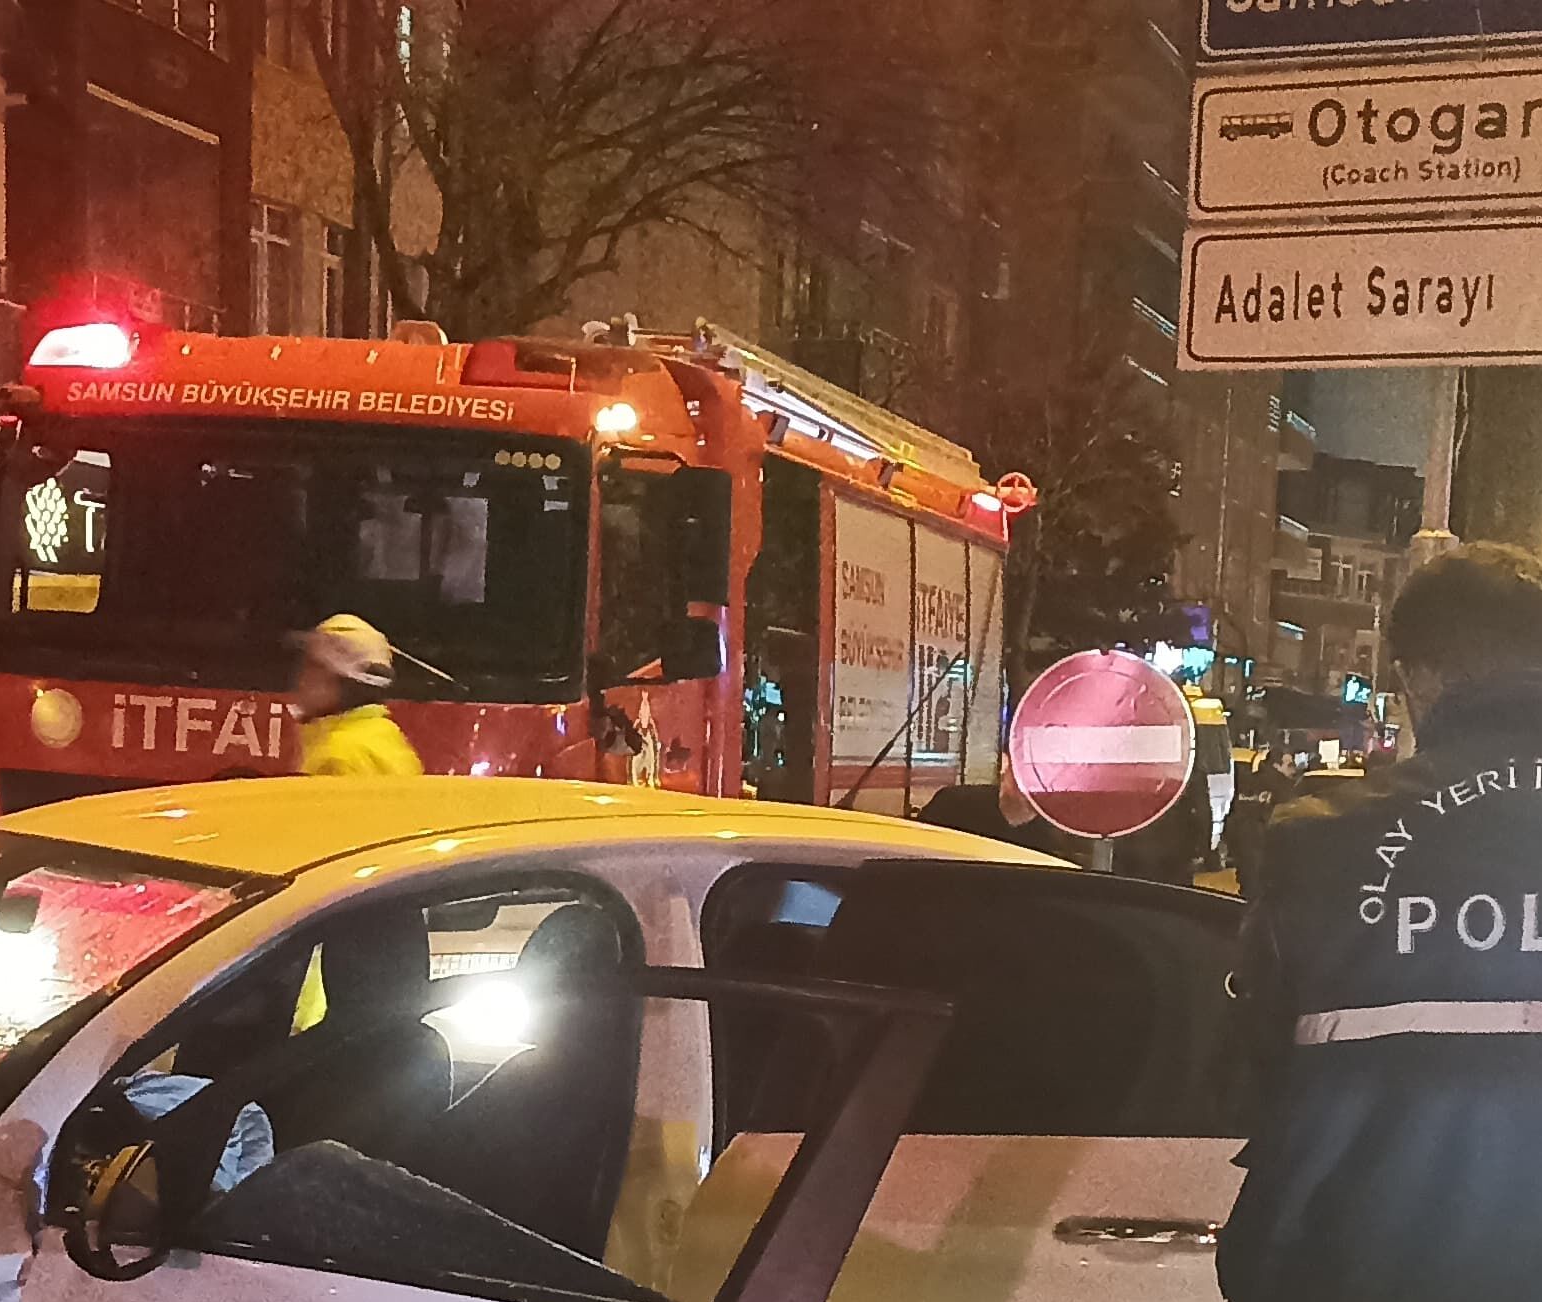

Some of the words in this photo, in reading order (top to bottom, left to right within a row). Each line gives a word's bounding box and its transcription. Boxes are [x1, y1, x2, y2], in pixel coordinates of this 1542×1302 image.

[1322, 160, 1408, 191] (Coach
[1418, 156, 1523, 184] Station)
[1214, 271, 1344, 325] Adalet
[1366, 266, 1495, 327] Sarayı
[67, 381, 175, 403] SAMSUN
[112, 693, 303, 759] İTFAİ
[1359, 817, 1414, 925] OLAY
[1421, 757, 1517, 817] YERİ
